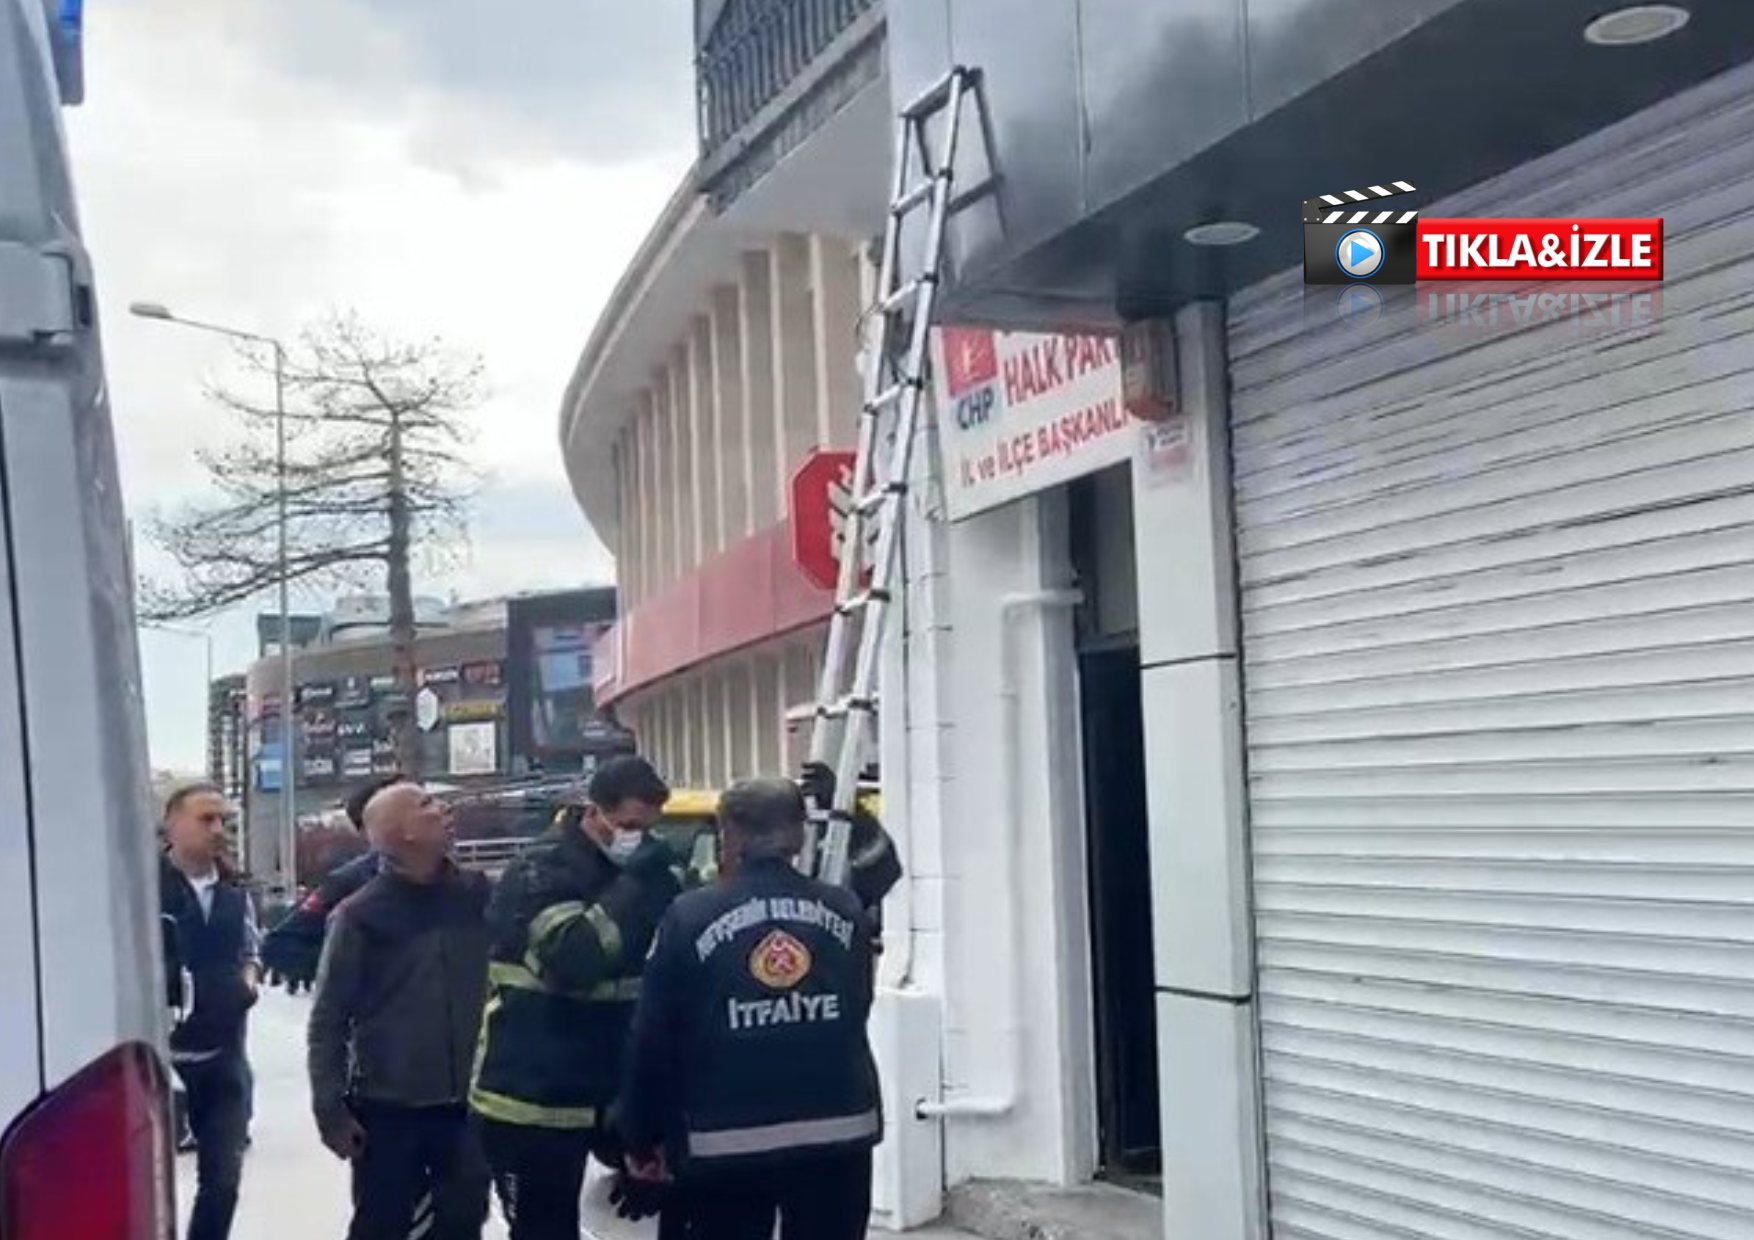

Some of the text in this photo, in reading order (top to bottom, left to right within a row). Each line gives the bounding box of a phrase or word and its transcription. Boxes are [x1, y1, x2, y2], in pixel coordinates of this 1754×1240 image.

[1004, 334, 1121, 406] HALK PAR
[957, 387, 994, 430] CHP
[977, 455, 995, 480] ve
[728, 991, 840, 1030] İTFAİYE
